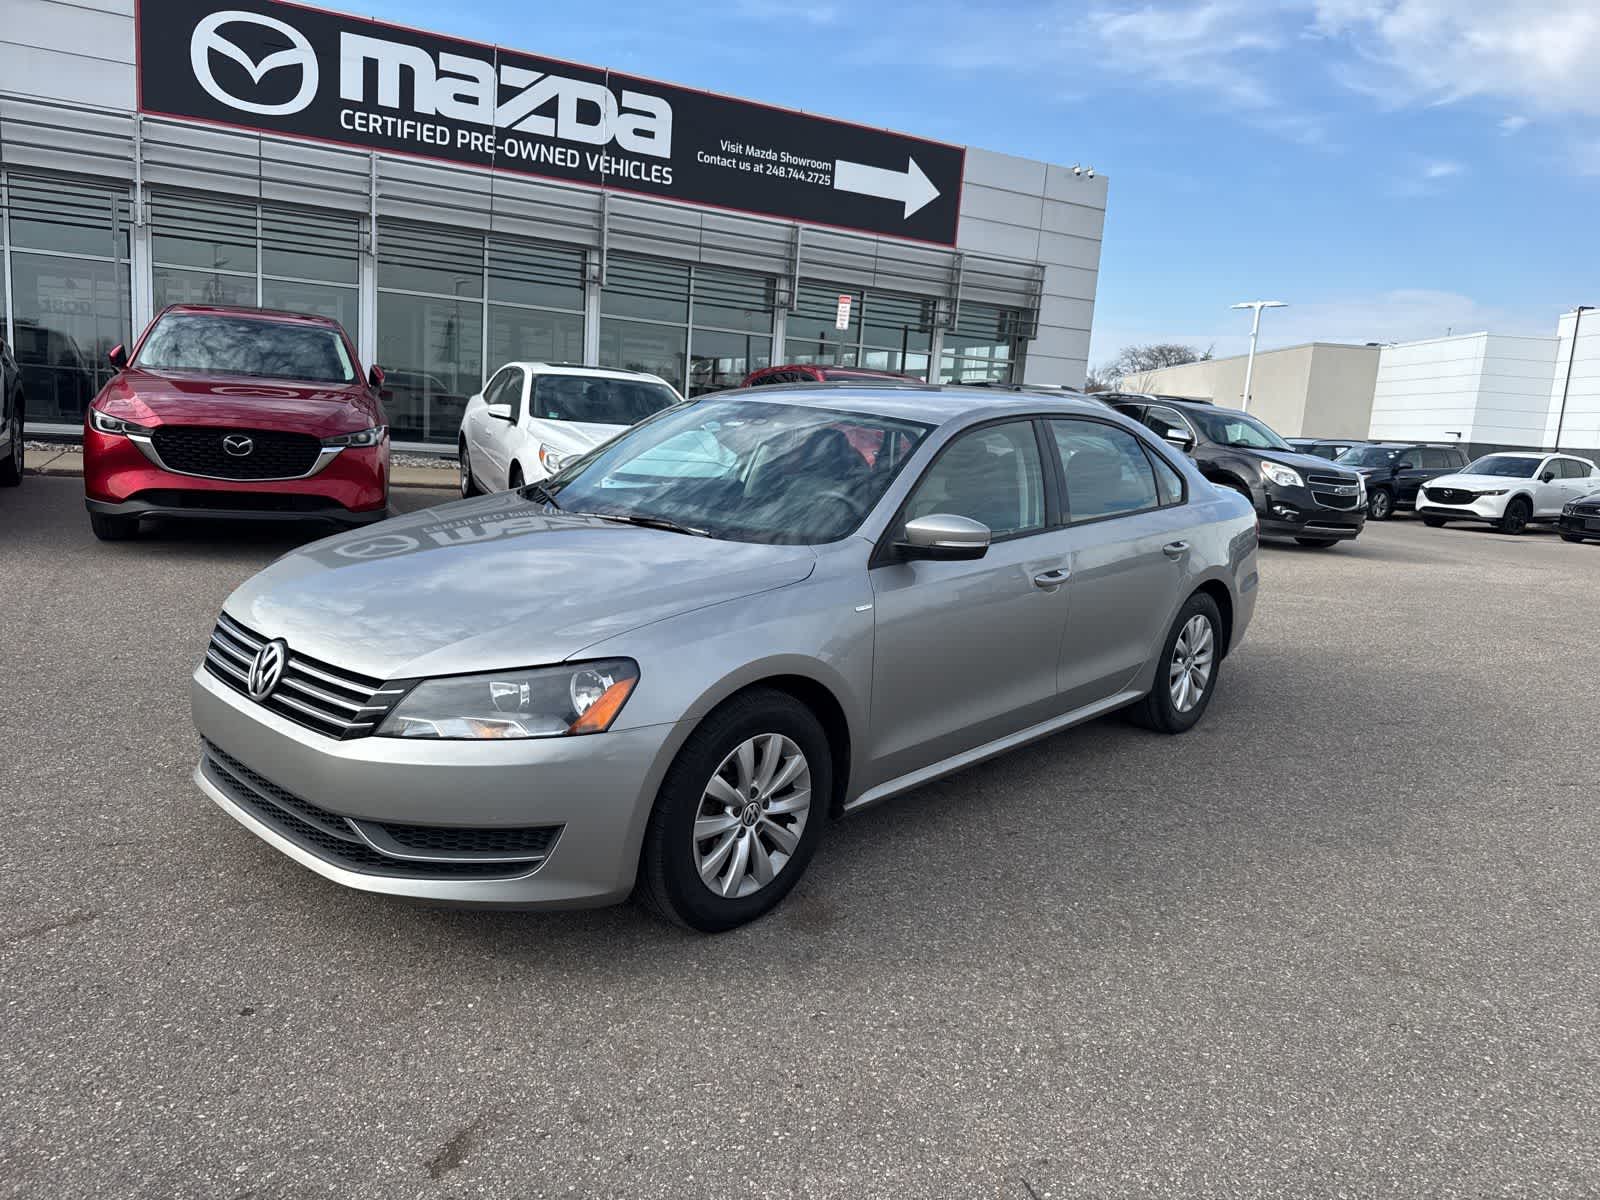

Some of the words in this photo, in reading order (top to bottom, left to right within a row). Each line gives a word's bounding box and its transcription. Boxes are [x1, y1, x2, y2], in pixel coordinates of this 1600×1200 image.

[340, 109, 450, 146] CERTIFIED
[456, 130, 580, 168] PRE-OWNED
[586, 152, 673, 185] VEHICLES
[720, 139, 743, 155] Visit
[745, 144, 778, 161] Mazda
[780, 151, 832, 171] Showroom
[697, 151, 736, 169] Contact
[739, 160, 751, 172] us
[753, 163, 764, 174] at
[766, 163, 831, 186] 248.744.2725
